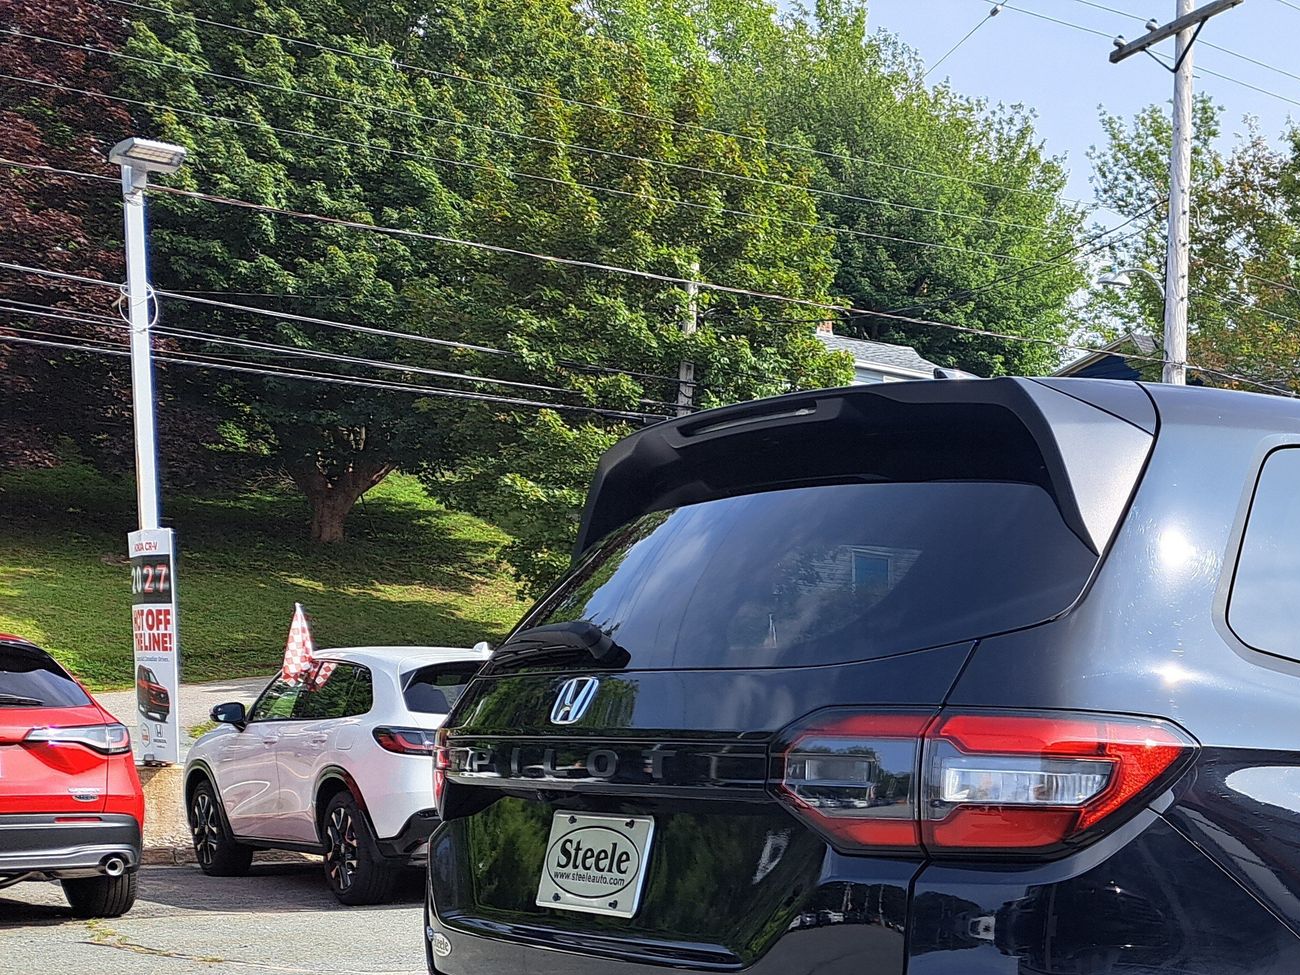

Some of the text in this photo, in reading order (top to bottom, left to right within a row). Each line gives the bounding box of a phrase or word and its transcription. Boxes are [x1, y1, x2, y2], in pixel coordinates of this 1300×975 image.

[131, 564, 169, 594] 2027
[145, 608, 171, 632] OFF
[143, 632, 172, 652] LINE!
[472, 747, 677, 779] PILOT
[556, 838, 631, 874] Steele
[553, 871, 625, 886] www.steeleauto.com
